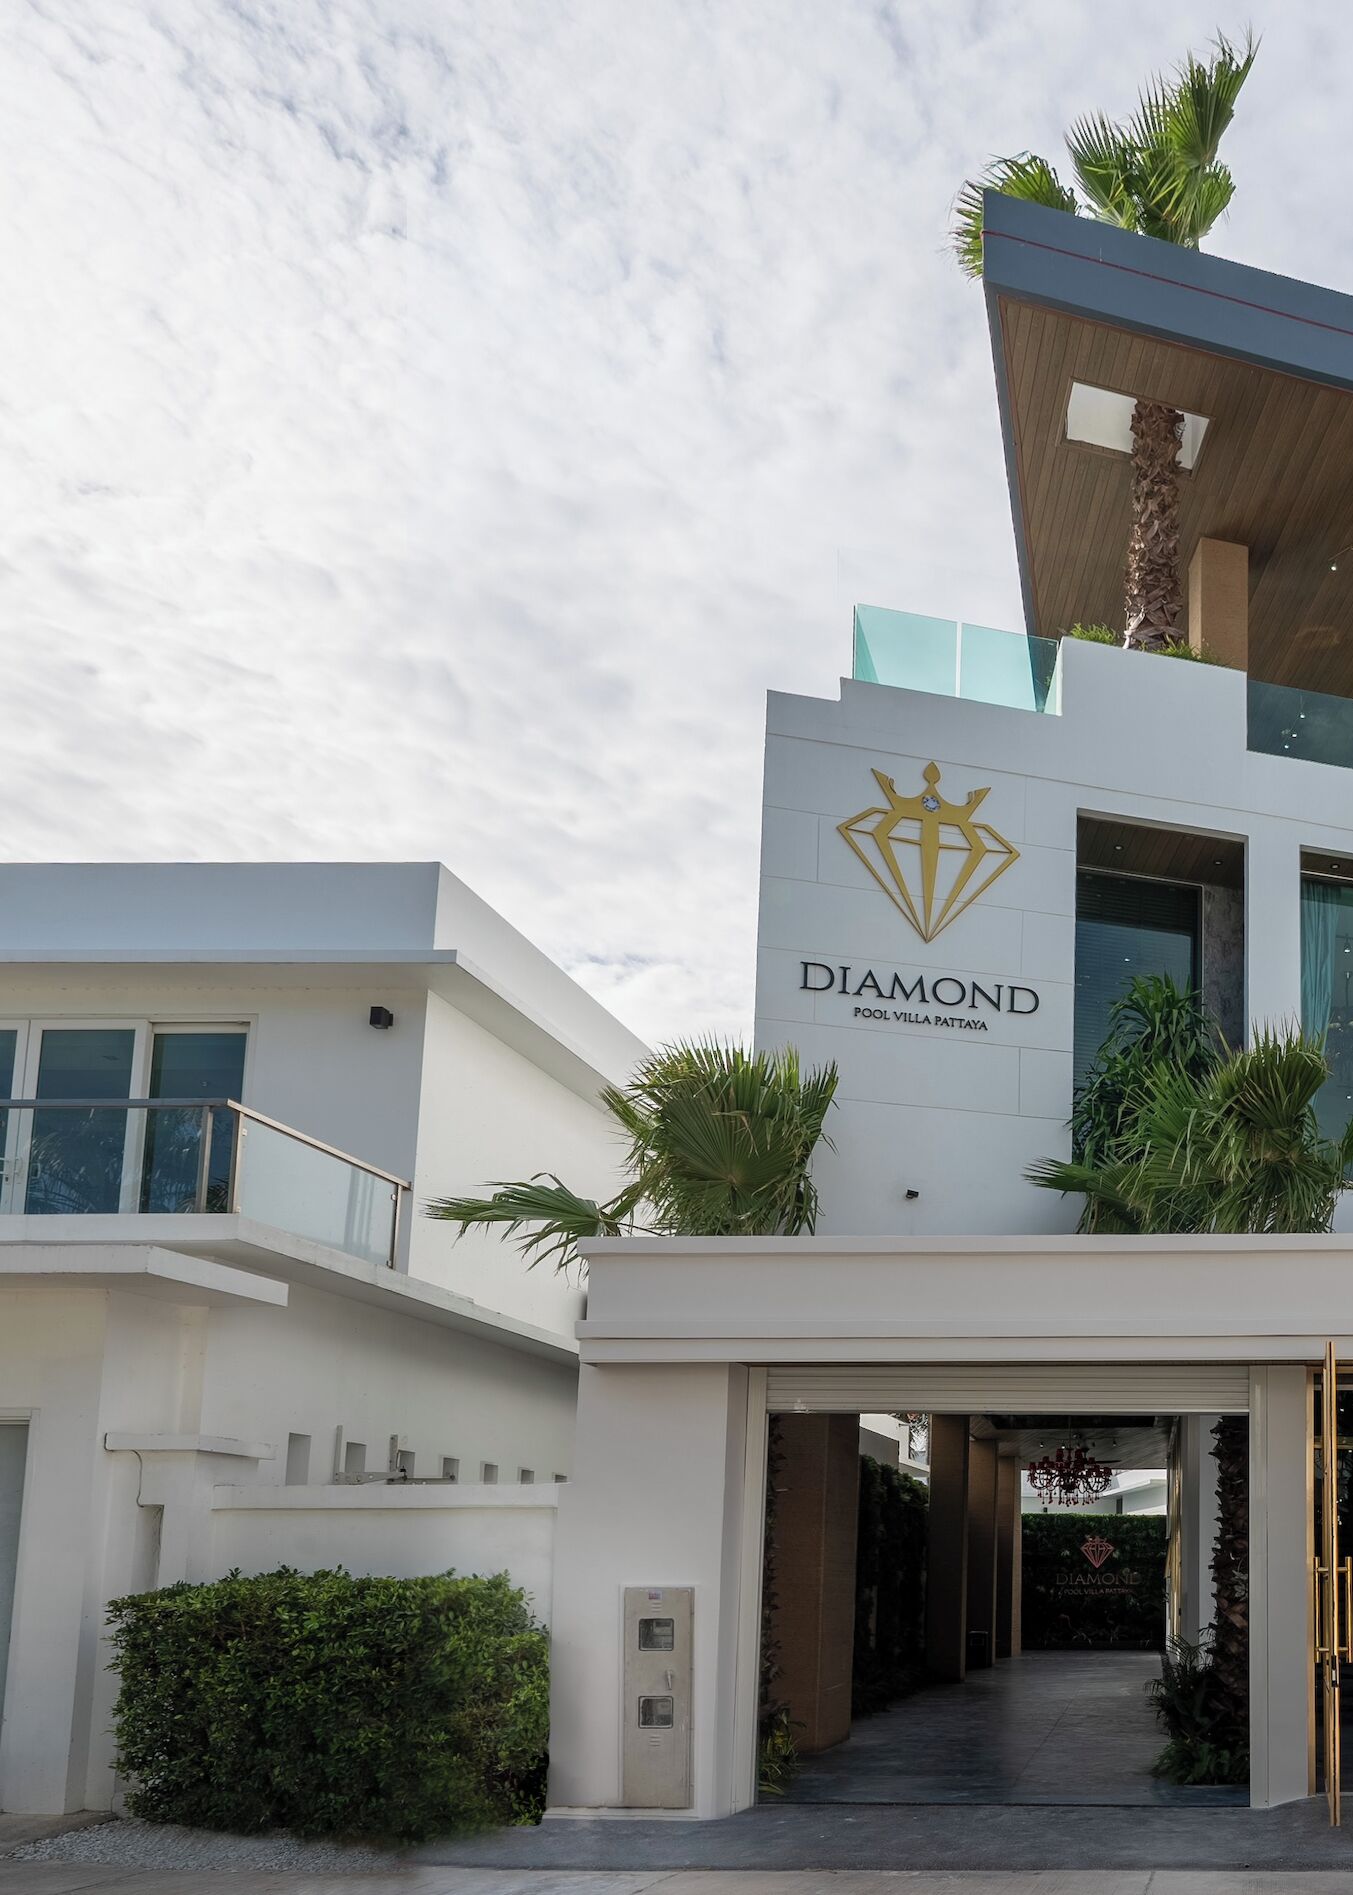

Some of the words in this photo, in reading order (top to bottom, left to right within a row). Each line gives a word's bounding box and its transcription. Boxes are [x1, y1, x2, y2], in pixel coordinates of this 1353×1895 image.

[800, 961, 1039, 1014] DIAMOND
[854, 1007, 890, 1021] POOL
[893, 1011, 931, 1025] VILLA
[934, 1016, 988, 1031] PATTAYA
